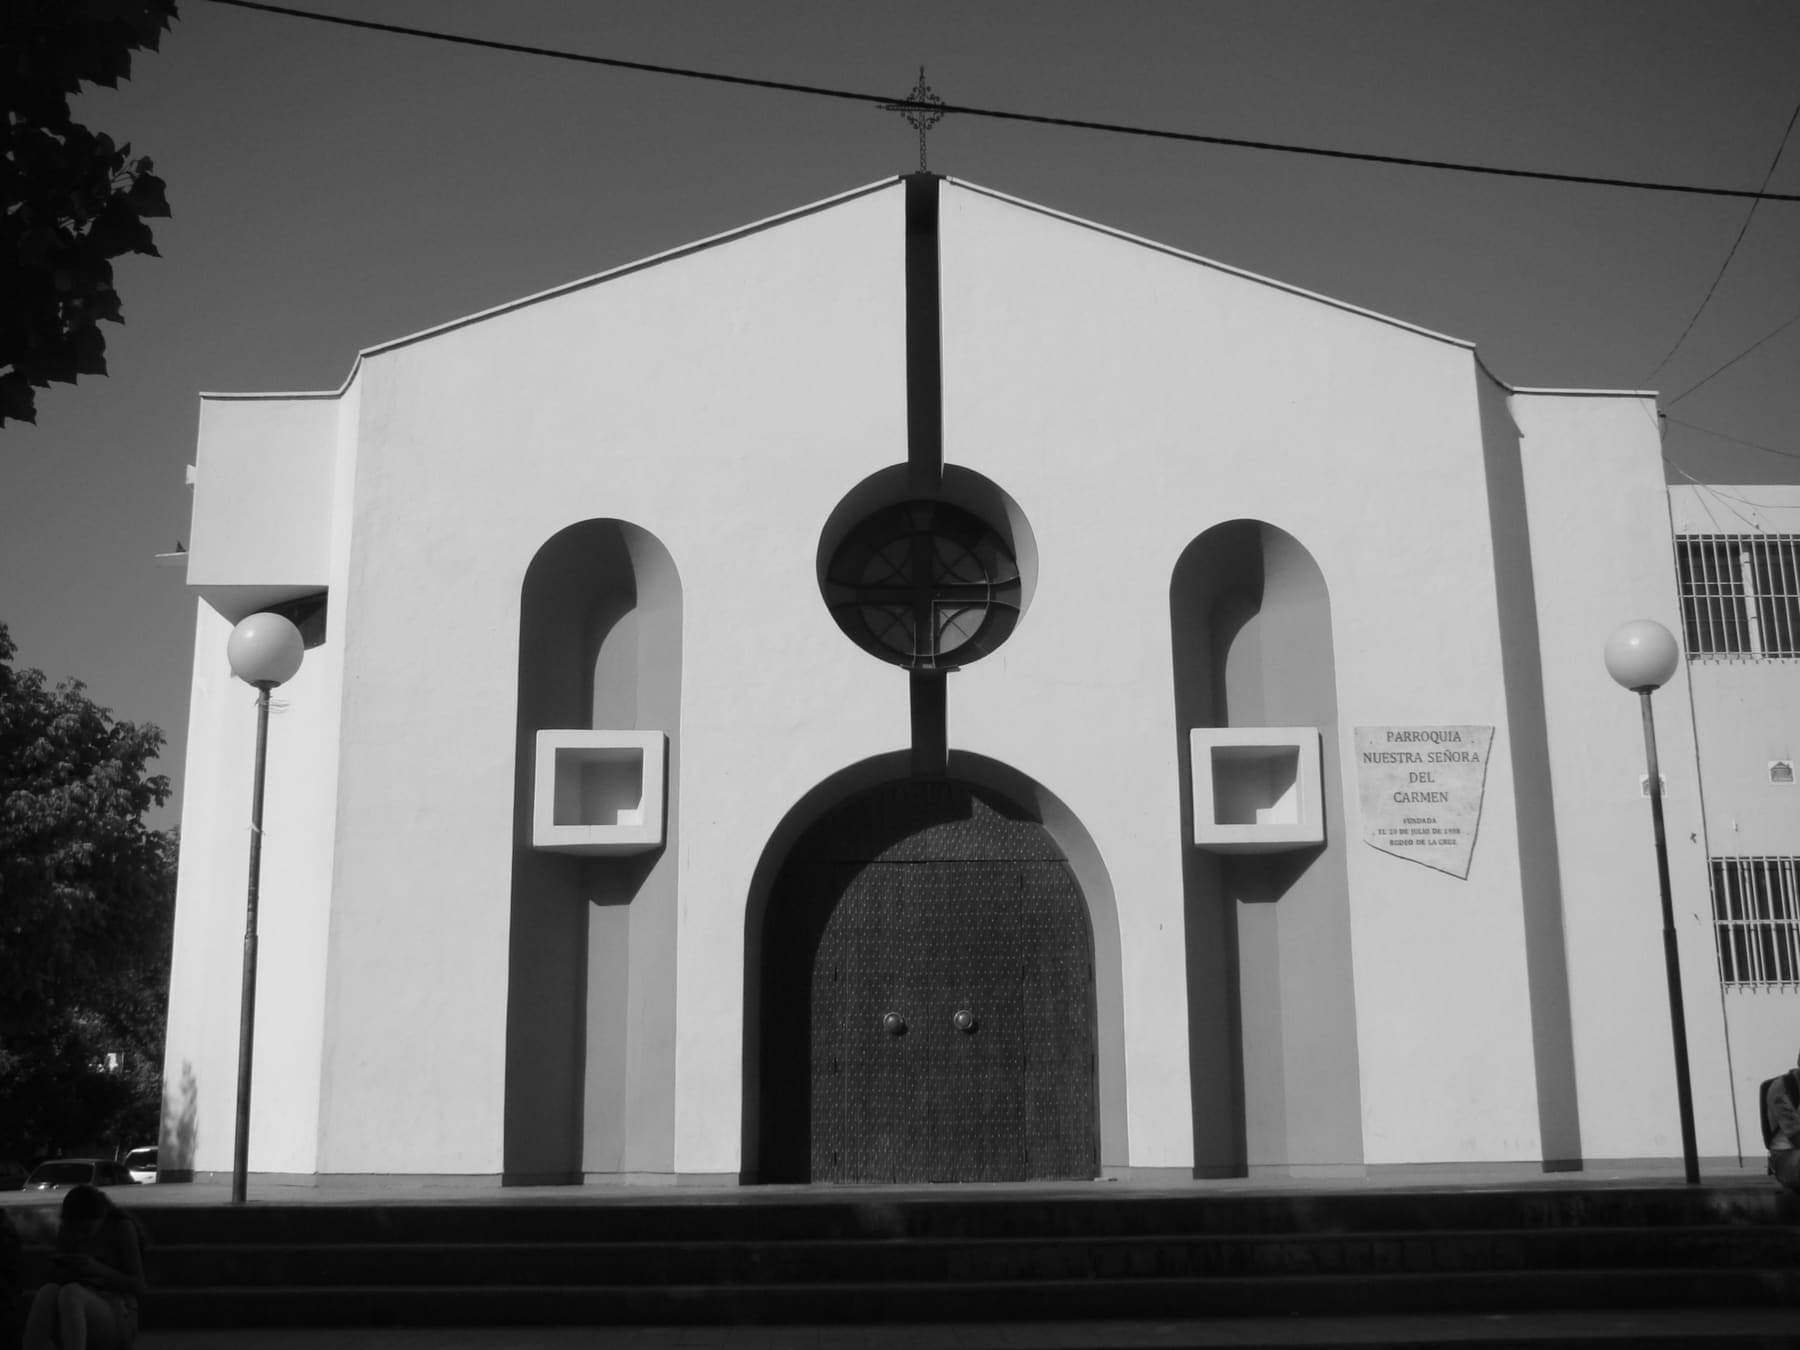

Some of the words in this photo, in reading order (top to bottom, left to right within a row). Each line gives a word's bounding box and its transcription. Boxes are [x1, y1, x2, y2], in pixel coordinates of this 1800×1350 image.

[1386, 731, 1462, 744] PARROQUIA
[1363, 752, 1423, 763] NUESTRA
[1427, 749, 1480, 763] SEÑORA
[1409, 772, 1435, 783] DEL
[1393, 791, 1449, 803] CARMEN
